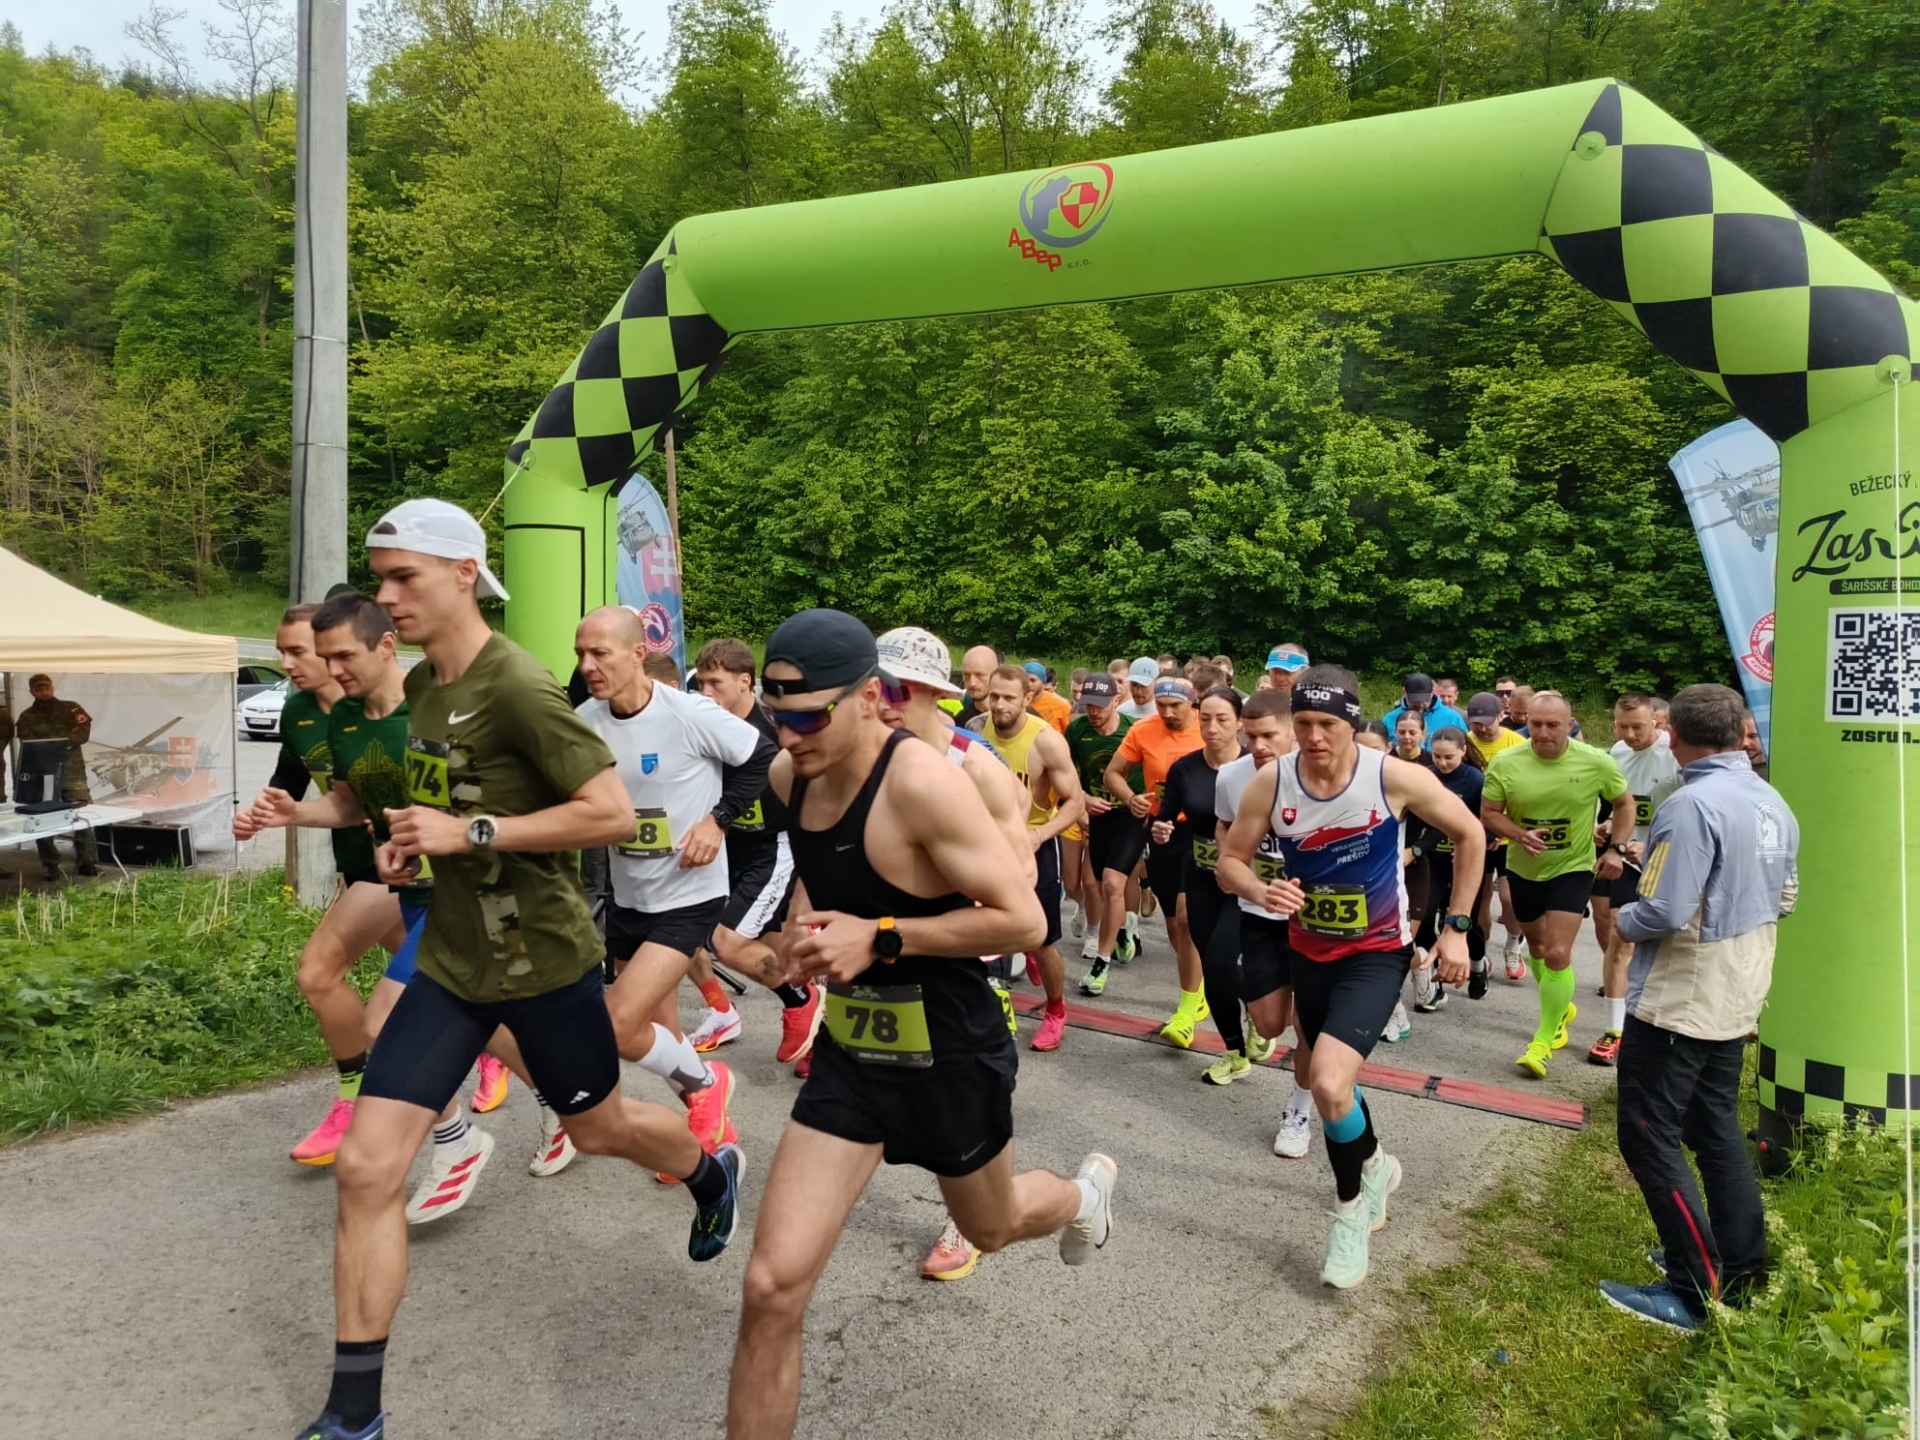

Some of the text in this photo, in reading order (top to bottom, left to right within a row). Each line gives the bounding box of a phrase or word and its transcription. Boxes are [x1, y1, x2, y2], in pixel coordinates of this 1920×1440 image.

[1849, 470, 1912, 496] BEŽECKÝ
[1841, 579, 1889, 592] ŠARIŠSKÉ
[1304, 690, 1331, 701] 100
[1302, 897, 1359, 923] 283
[846, 1005, 899, 1044] 78
